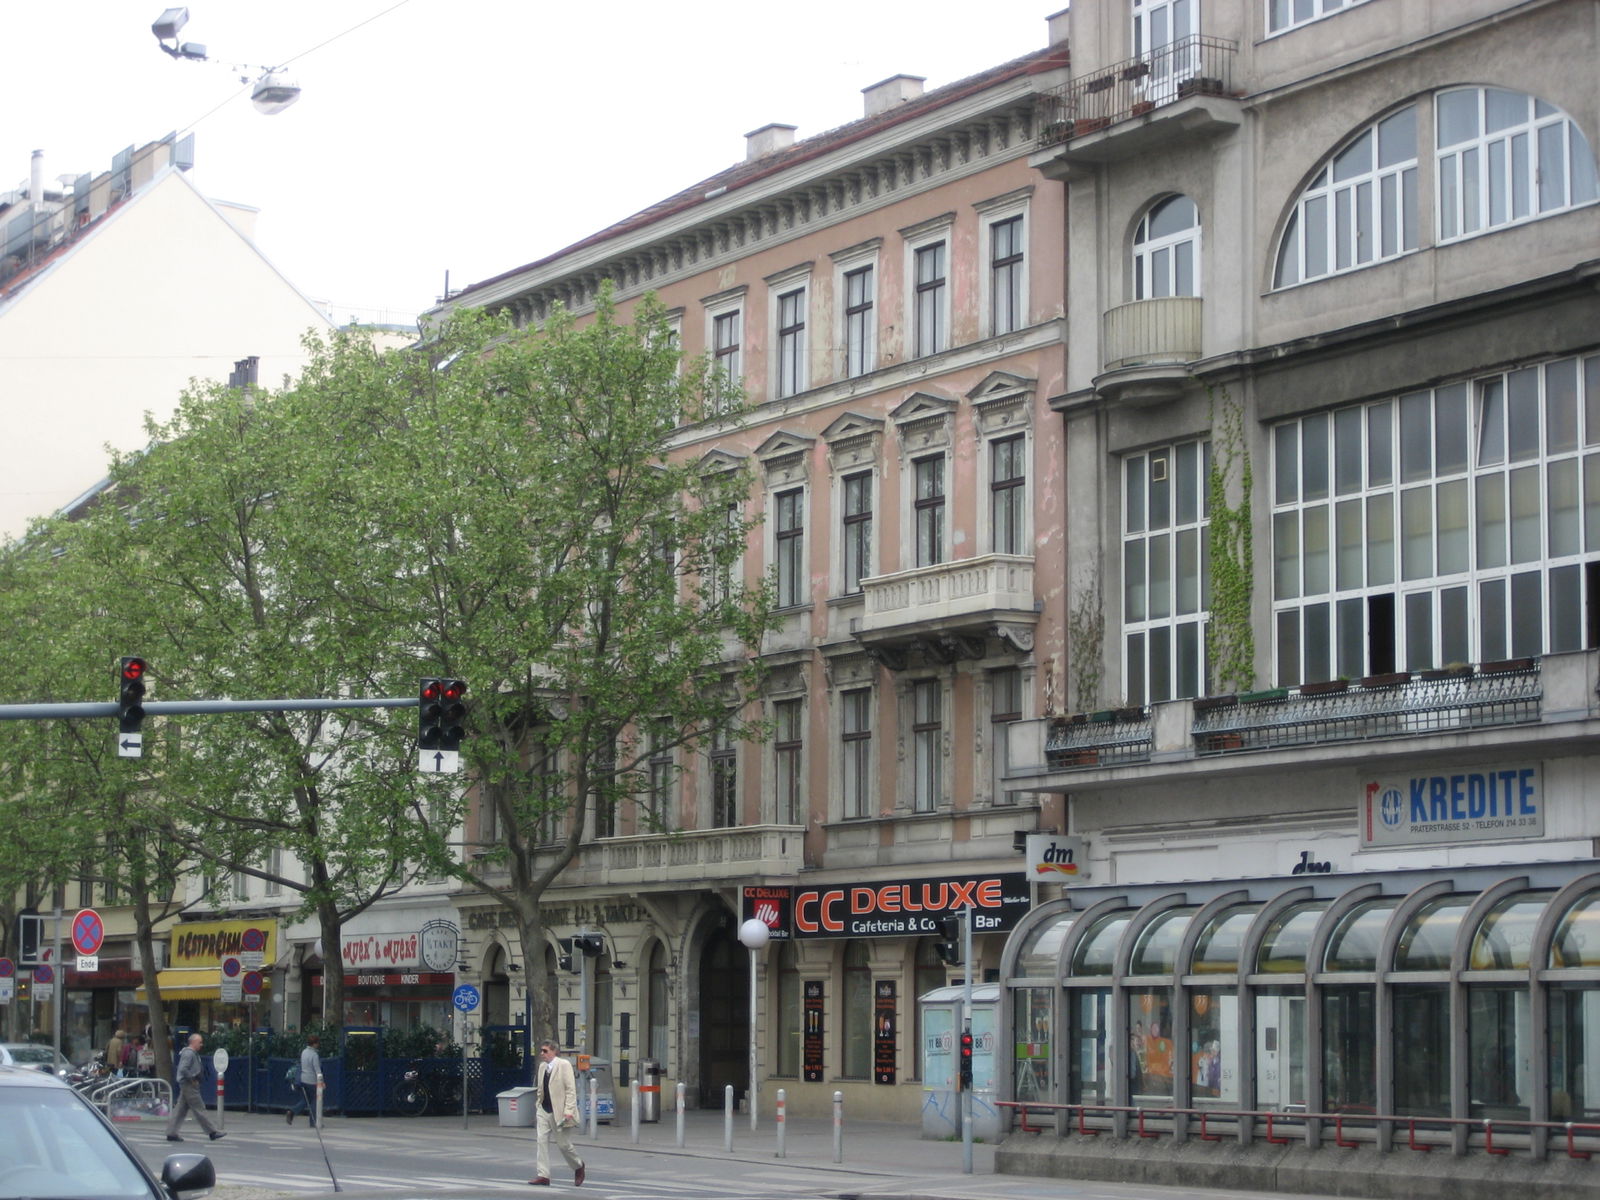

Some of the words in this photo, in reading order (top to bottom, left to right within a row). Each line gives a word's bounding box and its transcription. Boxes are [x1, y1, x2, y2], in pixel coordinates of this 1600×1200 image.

[1410, 769, 1536, 823] KREDITE
[1410, 823, 1460, 833] PRATERSTRASSE
[1476, 820, 1504, 829] TELEFON
[1043, 842, 1074, 863] dm
[1292, 851, 1332, 875] dm
[744, 888, 756, 898] CC
[756, 888, 790, 899] DELUXE
[795, 890, 845, 933] CC
[851, 879, 1002, 915] DELUXE
[755, 904, 779, 926] illy
[975, 915, 1002, 928] Bar
[852, 919, 905, 933] Cafeteria
[908, 918, 918, 931] &
[80, 959, 96, 969] Ende
[358, 975, 385, 985] BOUTIQUE
[401, 974, 419, 984] KINDER
